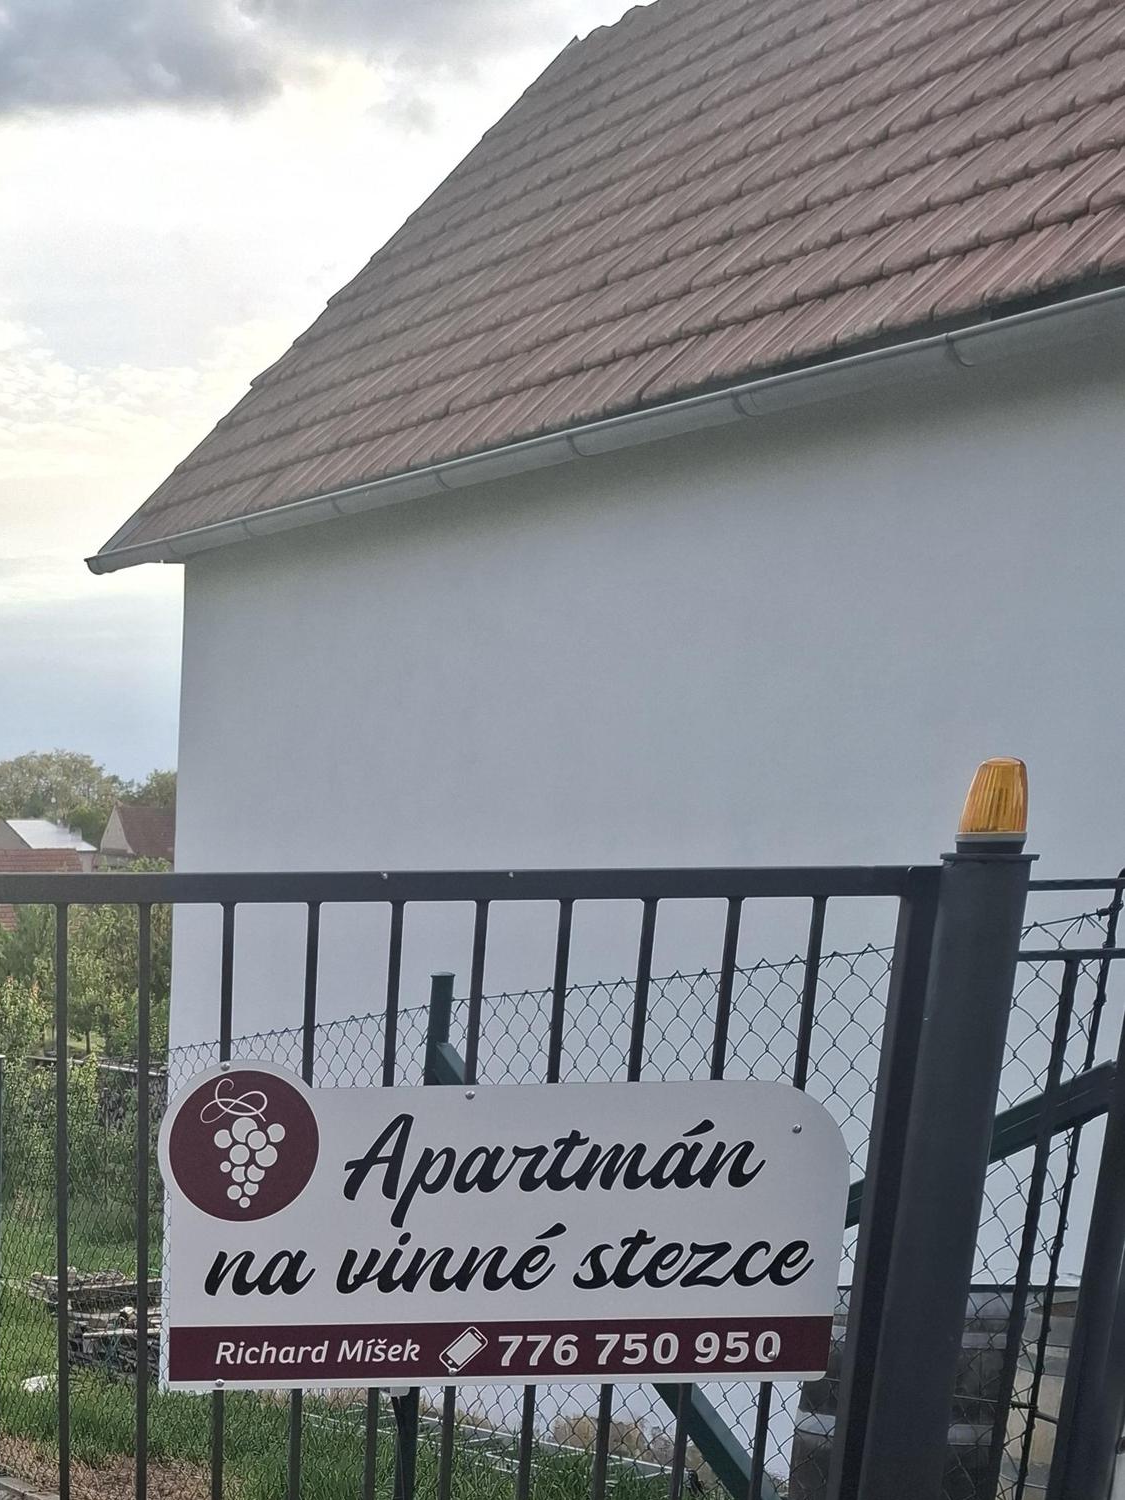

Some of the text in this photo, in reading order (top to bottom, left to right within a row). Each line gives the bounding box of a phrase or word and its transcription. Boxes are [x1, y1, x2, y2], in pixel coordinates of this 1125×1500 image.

[343, 1113, 766, 1228] Apartmán
[204, 1223, 815, 1297] na vinné stezce
[215, 1331, 781, 1367] Richard Míšek 776 750 950
